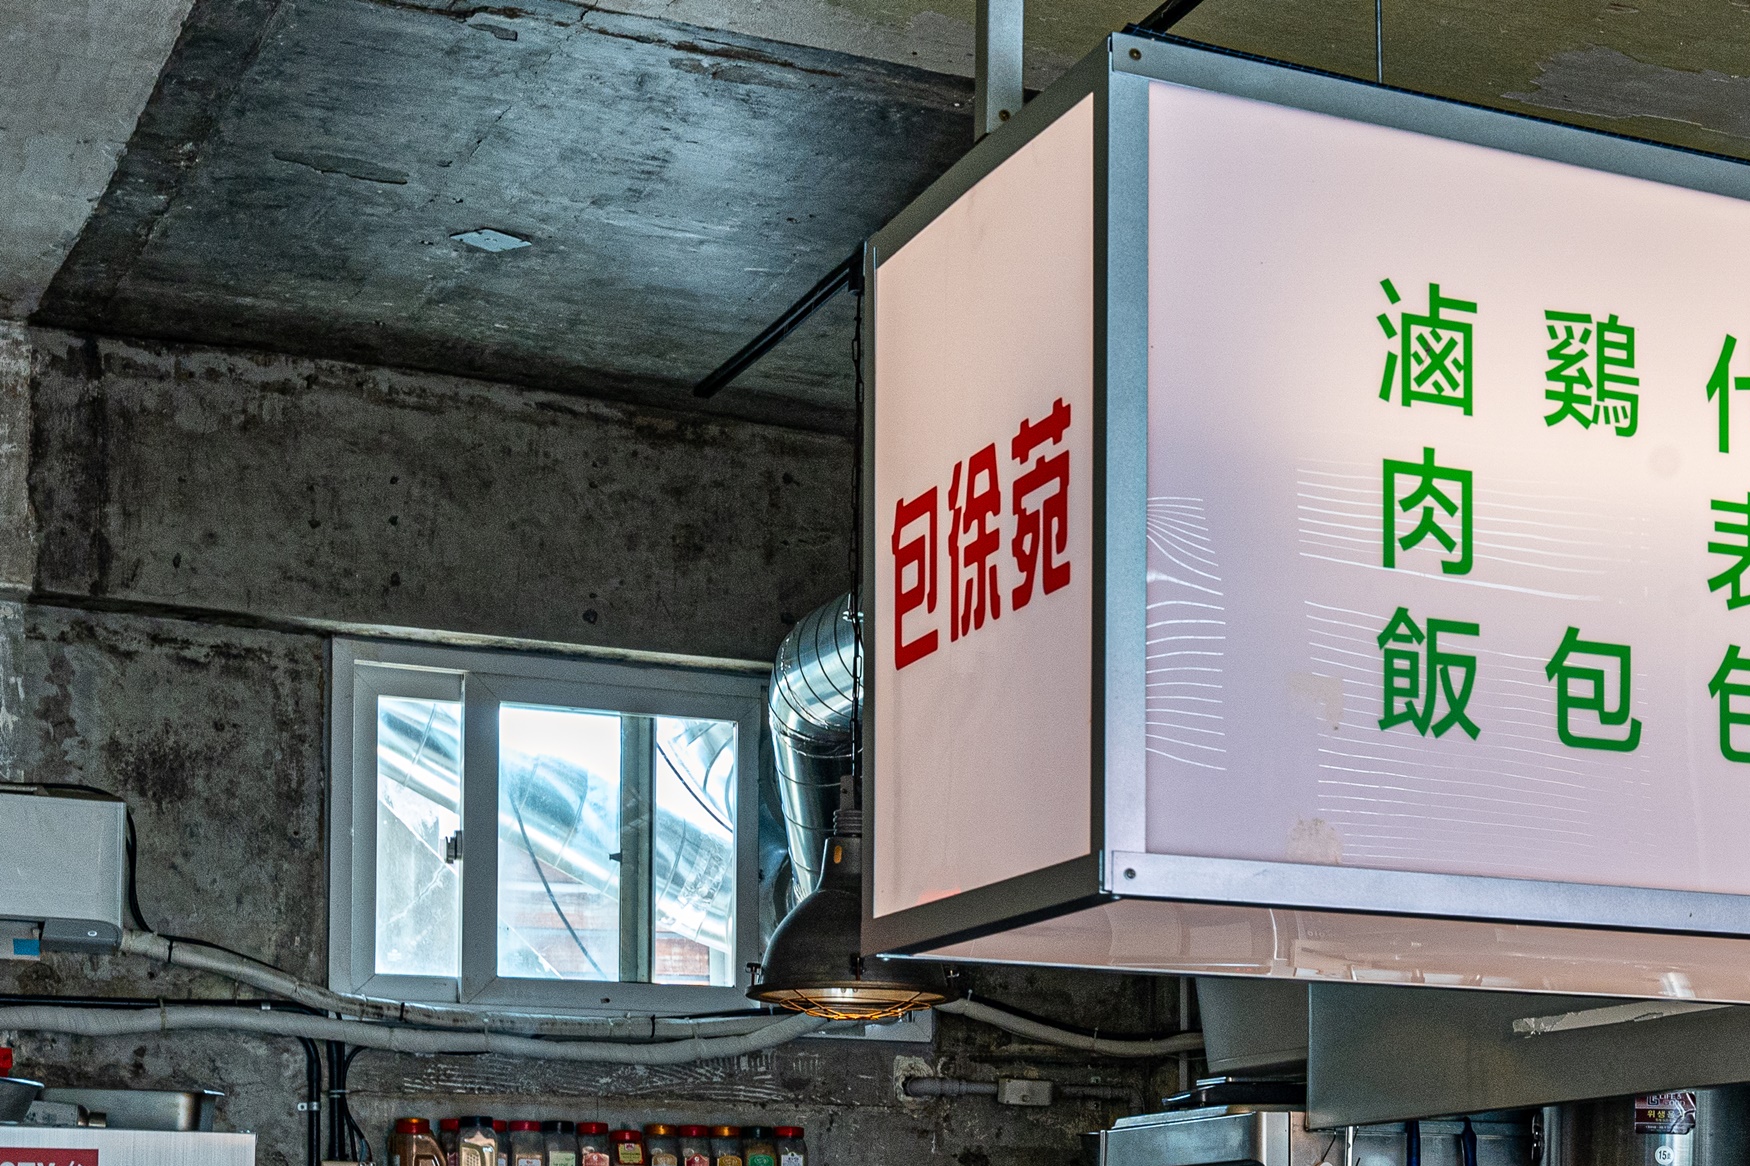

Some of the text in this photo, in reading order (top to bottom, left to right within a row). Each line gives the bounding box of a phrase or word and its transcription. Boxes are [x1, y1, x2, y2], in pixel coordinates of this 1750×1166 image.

[892, 397, 1071, 671] 包徐苑
[1376, 278, 1481, 741] 滷肉飯
